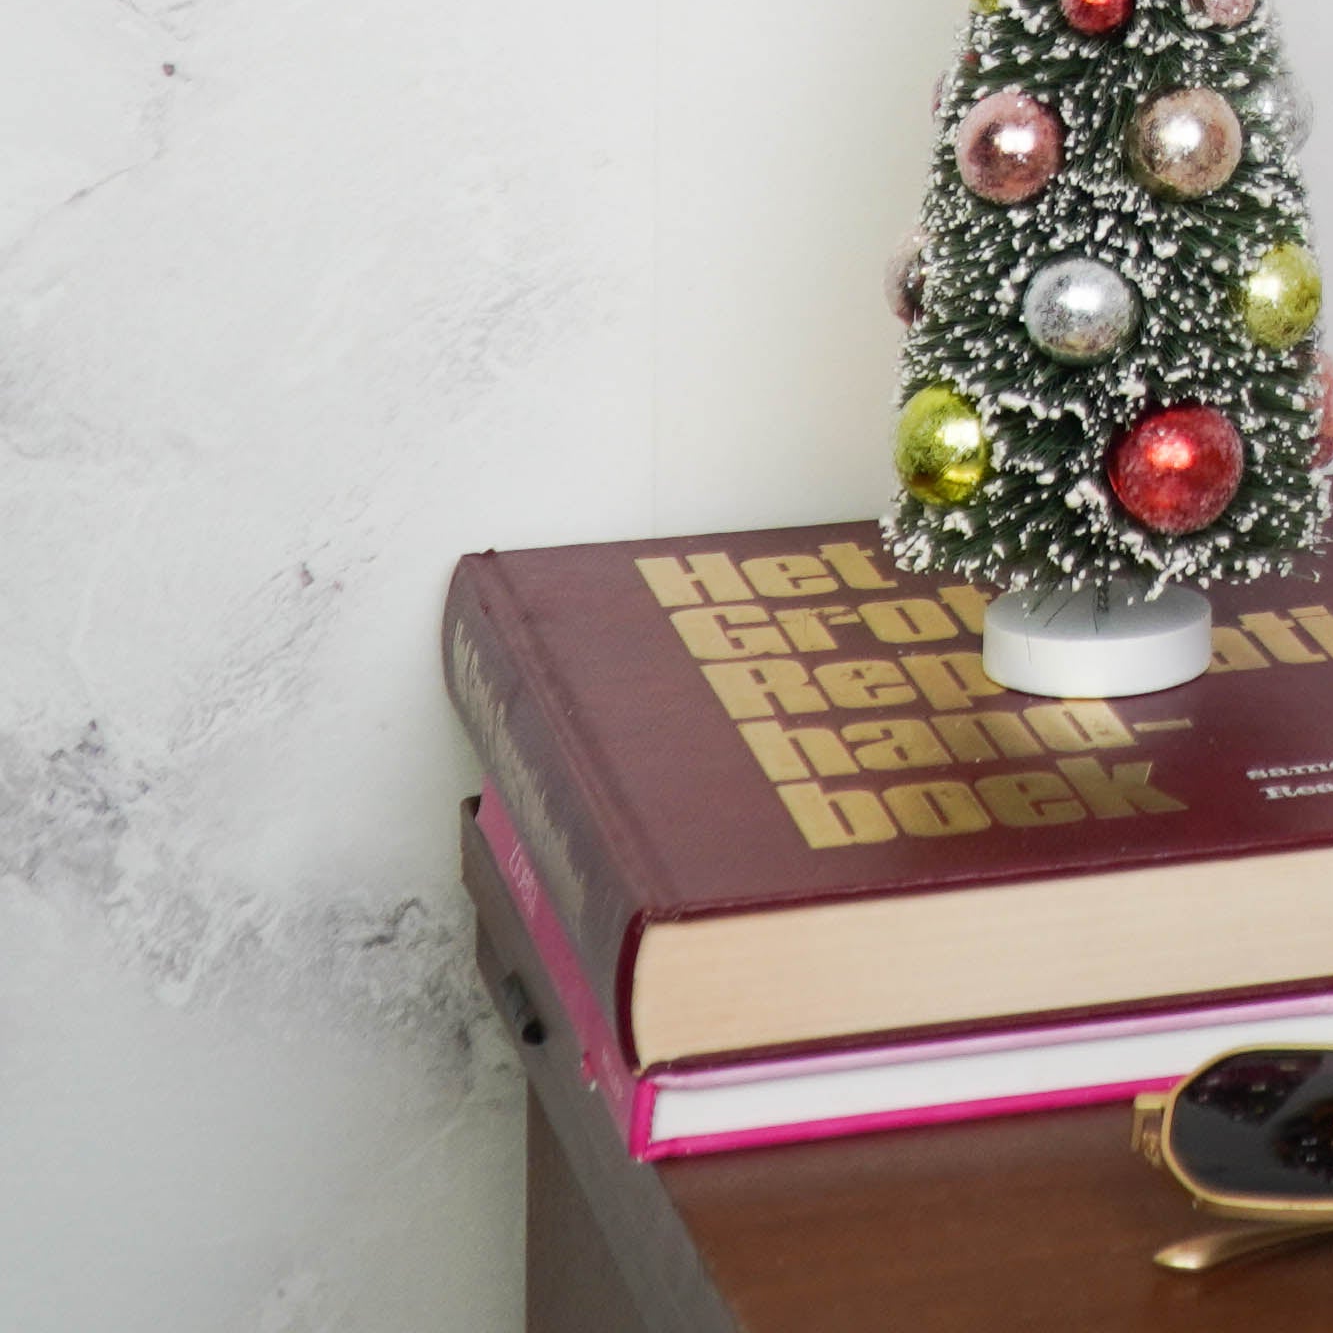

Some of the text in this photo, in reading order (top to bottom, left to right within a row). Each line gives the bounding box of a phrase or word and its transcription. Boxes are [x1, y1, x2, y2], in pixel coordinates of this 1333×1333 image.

[634, 541, 898, 608] Het
[669, 584, 993, 661] Grot
[735, 699, 1194, 783] hand-
[775, 756, 1189, 851] boek
